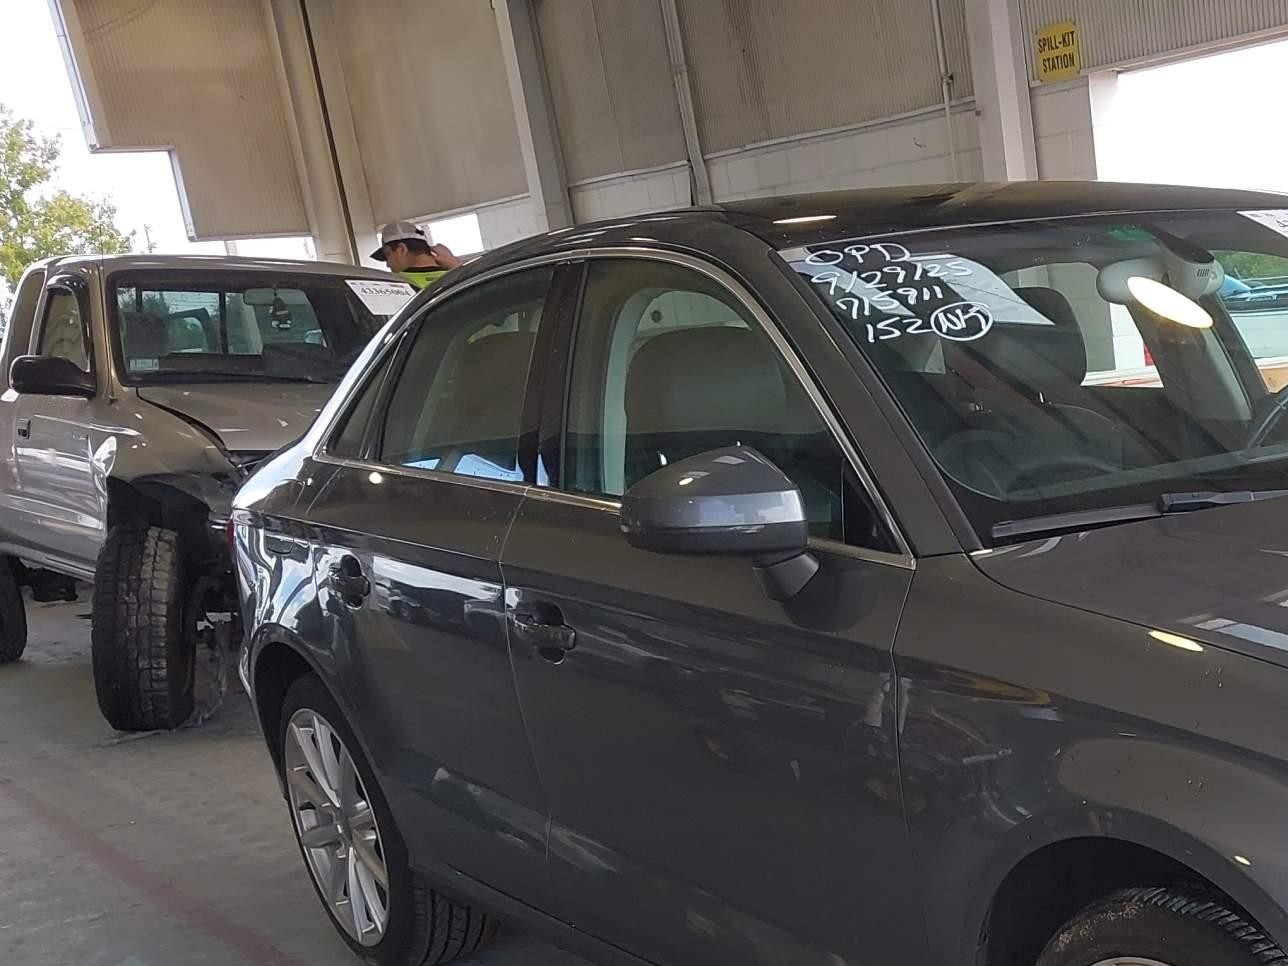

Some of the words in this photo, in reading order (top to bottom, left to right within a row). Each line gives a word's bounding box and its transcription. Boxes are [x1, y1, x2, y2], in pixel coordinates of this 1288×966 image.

[1038, 31, 1075, 53] SPILL-KIT
[1042, 53, 1075, 73] STATION
[811, 261, 973, 295] 9/29/25
[866, 315, 932, 343] 152
